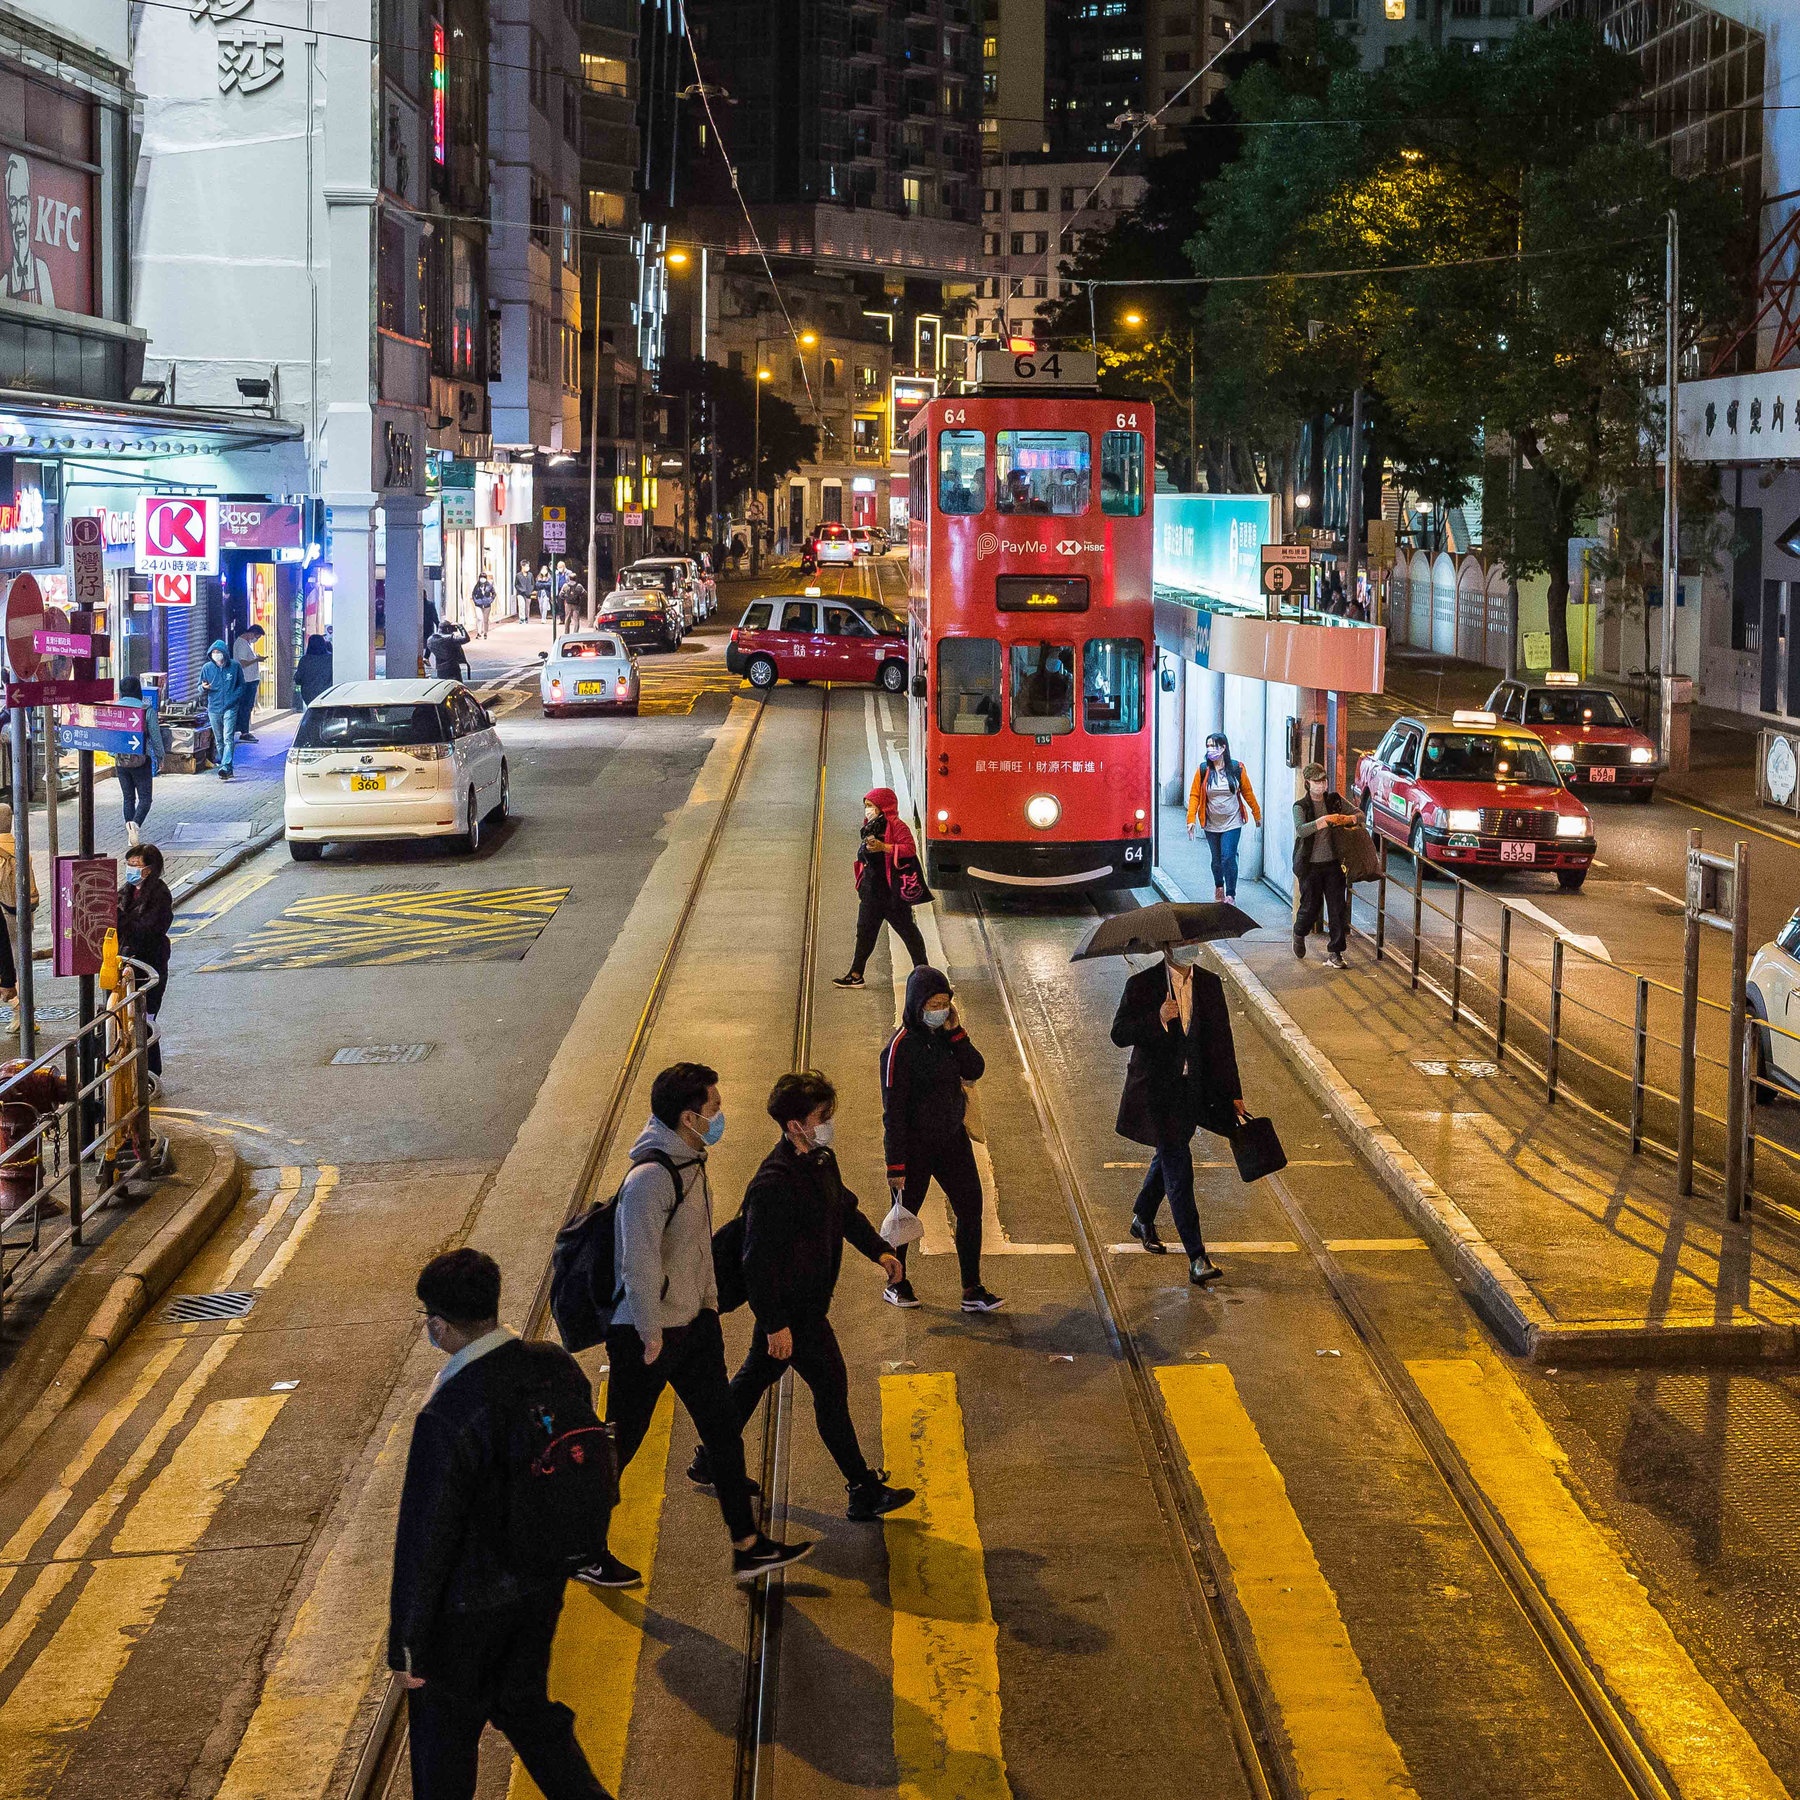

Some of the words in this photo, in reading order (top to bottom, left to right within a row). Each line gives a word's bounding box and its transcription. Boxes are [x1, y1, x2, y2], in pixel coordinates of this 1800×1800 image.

[35, 195, 82, 252] KFC
[1014, 354, 1063, 379] 64
[944, 409, 966, 424] 64
[1116, 414, 1137, 428] 64
[111, 513, 135, 543] Circle
[1002, 540, 1047, 554] PayMe
[1084, 544, 1105, 552] HSBC
[141, 559, 210, 572] 24小時營業
[77, 552, 101, 597] 灣仔
[357, 781, 379, 791] 360
[1125, 847, 1143, 861] 64
[1510, 843, 1525, 853] KY
[1501, 852, 1534, 862] 3329
